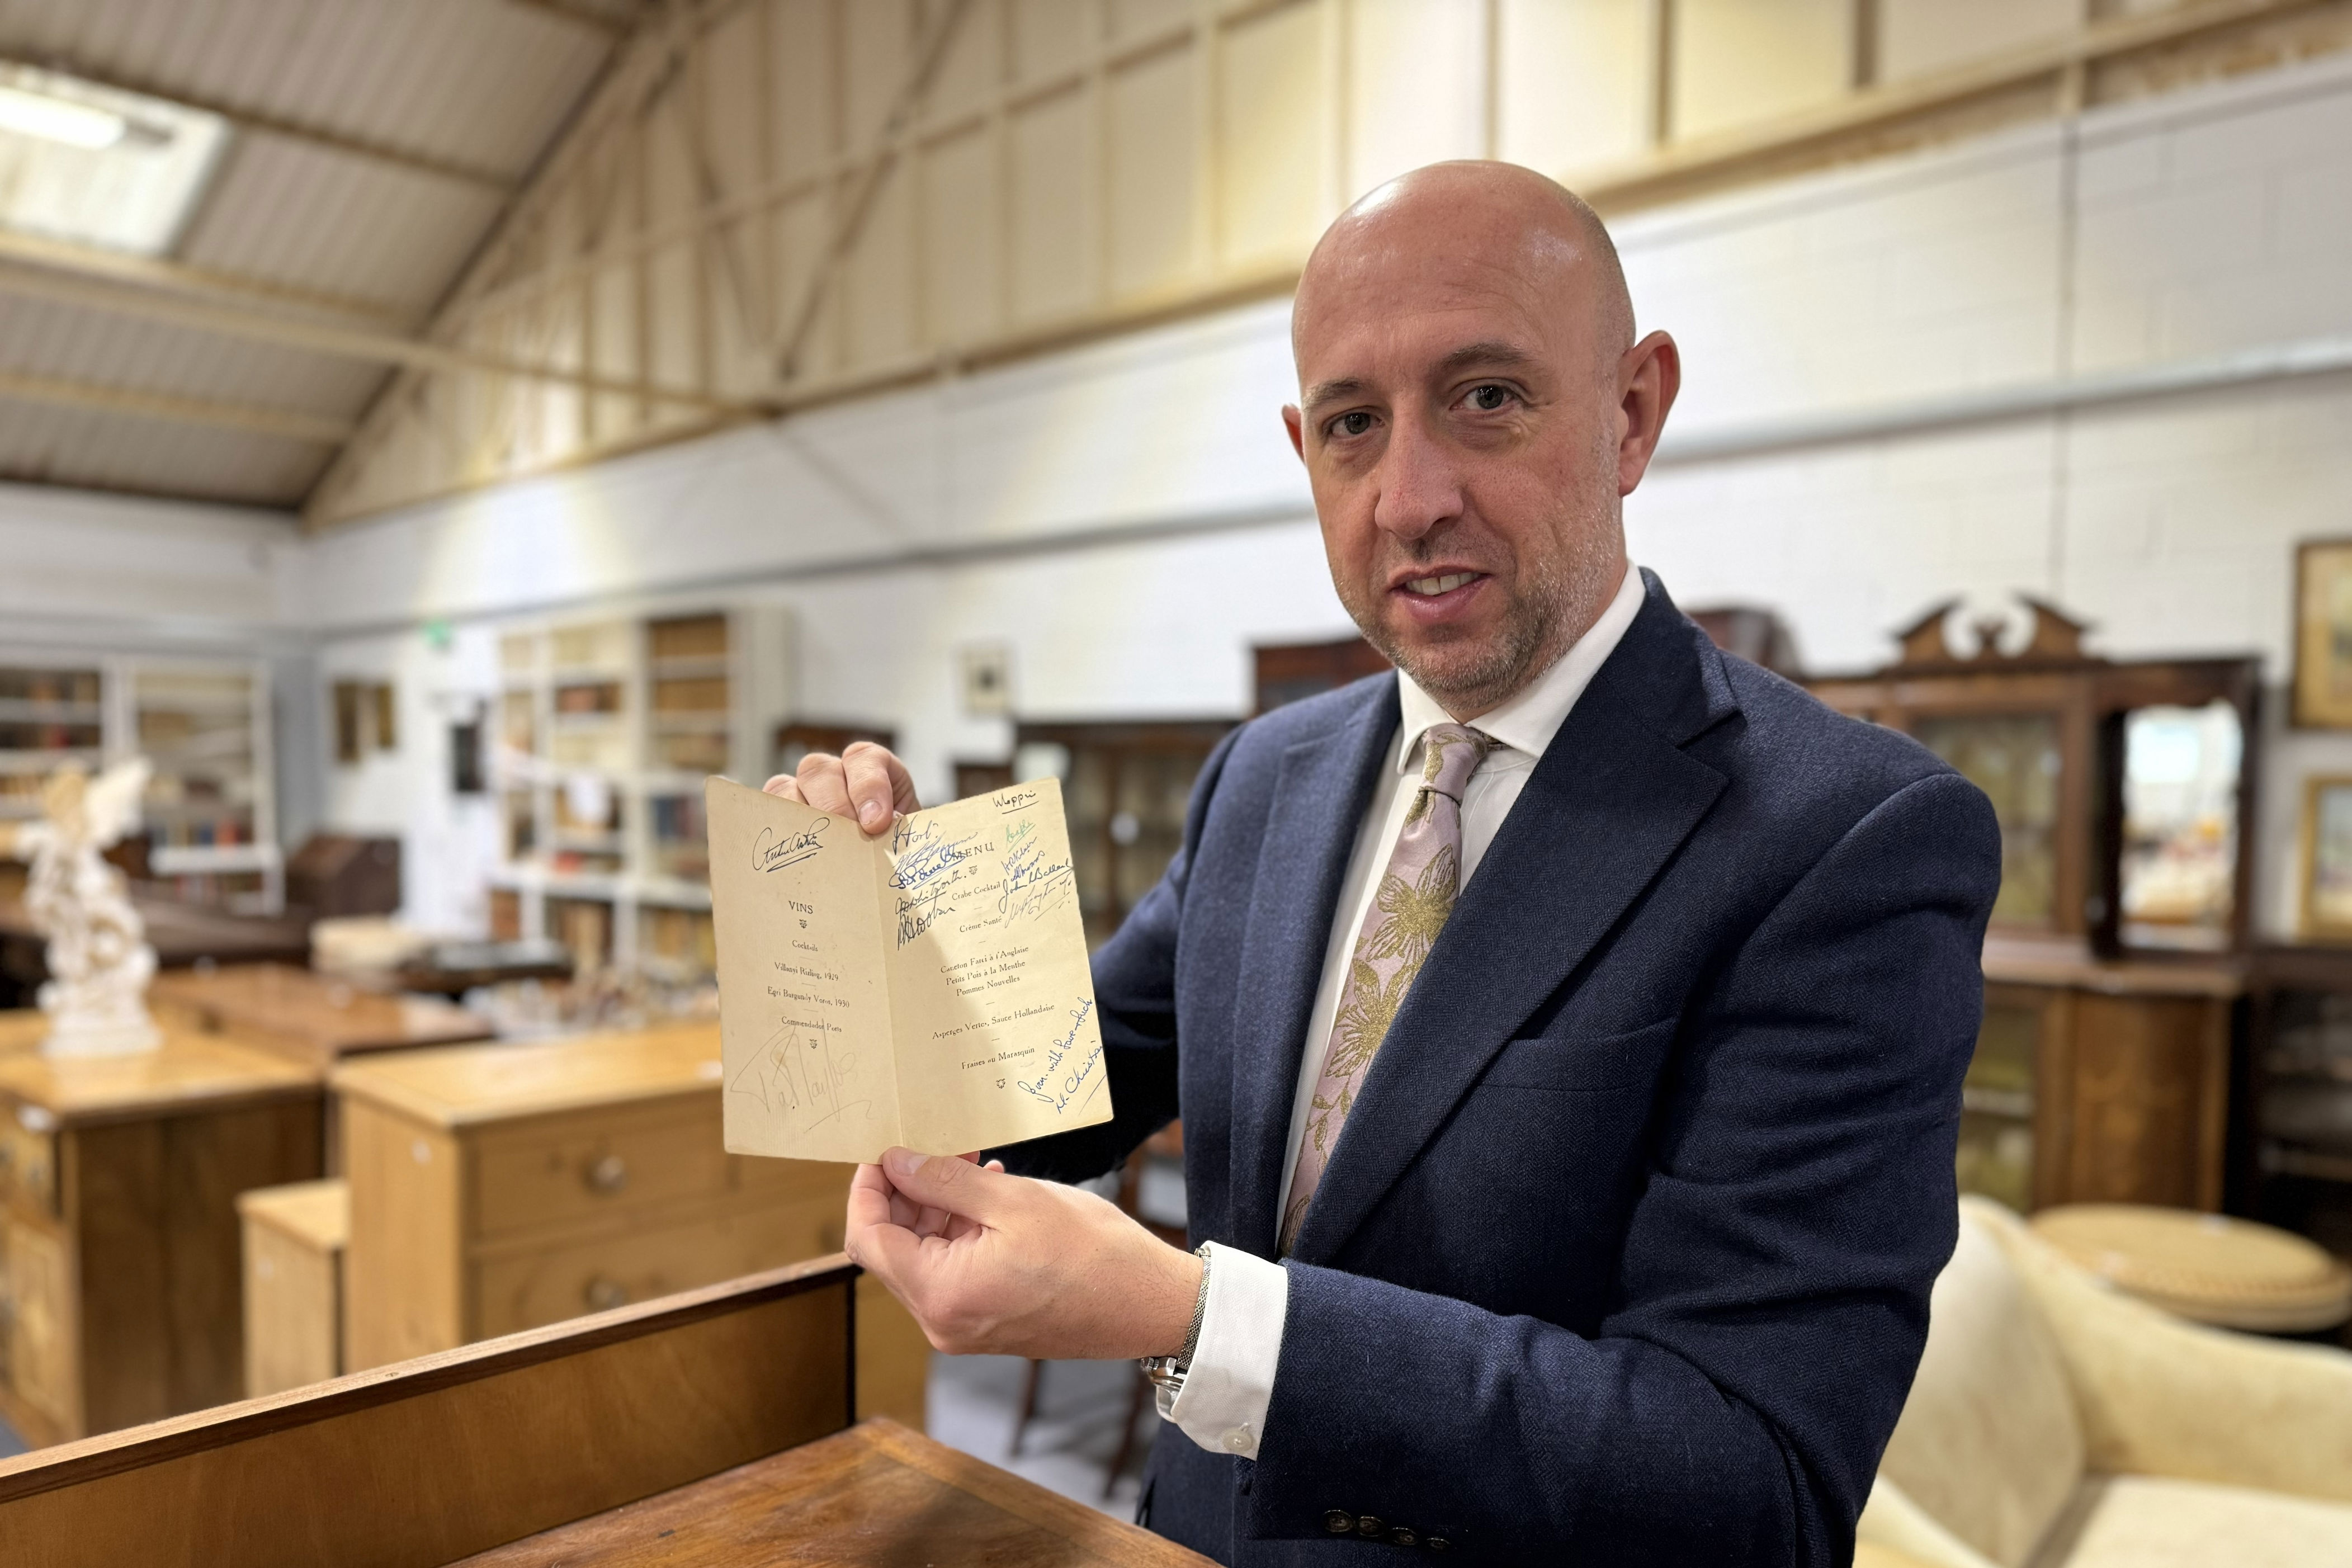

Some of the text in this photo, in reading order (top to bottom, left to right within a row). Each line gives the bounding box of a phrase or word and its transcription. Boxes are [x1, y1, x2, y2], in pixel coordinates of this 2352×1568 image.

[952, 842, 994, 861] MENU
[952, 881, 1000, 900] Crabe Cocktail
[788, 900, 813, 914] VINS
[983, 915, 1002, 927] Santé
[792, 939, 818, 952] Cocktails
[774, 961, 798, 975] Villanyi
[824, 972, 839, 981] 1929
[946, 975, 965, 986] Petits
[967, 970, 982, 980] Pois
[990, 966, 996, 975] la
[999, 960, 1026, 972] Menthe
[956, 975, 1021, 996] Pommes Nouvelles
[783, 989, 811, 1003] Burgundy
[835, 999, 849, 1008] 1930
[781, 1016, 842, 1033] Commendador Ports
[932, 1026, 963, 1040] Asperges
[991, 1014, 1012, 1024] Sauce
[1014, 1004, 1055, 1019] Hollandaise
[961, 1059, 985, 1070] Fraises
